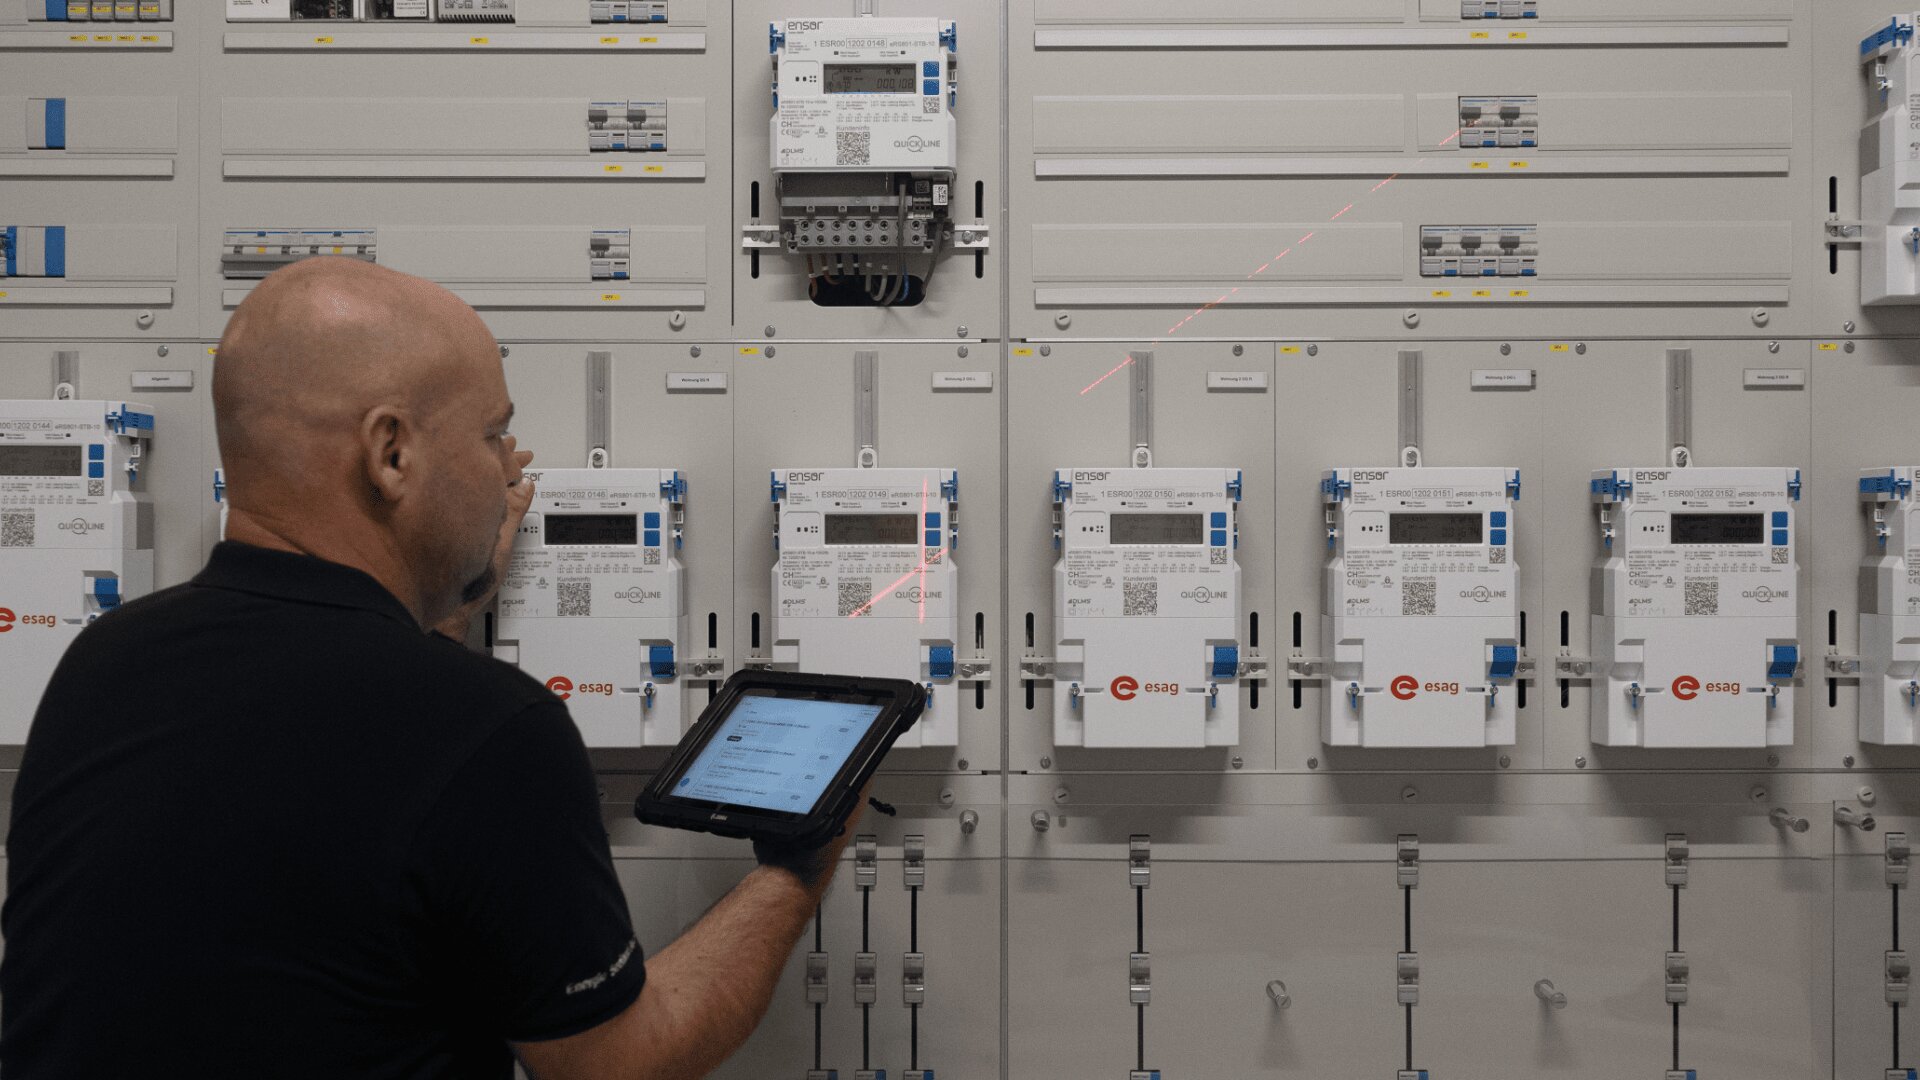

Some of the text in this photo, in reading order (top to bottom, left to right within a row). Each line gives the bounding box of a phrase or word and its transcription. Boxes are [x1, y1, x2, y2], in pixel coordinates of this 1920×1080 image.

[847, 40, 866, 48] 1202
[13, 422, 31, 430] 1202
[32, 422, 51, 430] 0144
[541, 491, 567, 499] ESR00
[868, 490, 887, 498] 0149
[1154, 490, 1173, 498] 0150
[1386, 490, 1412, 498] ESR00
[1668, 490, 1694, 498] ESR00
[22, 614, 56, 628] esag
[579, 683, 613, 696] esag
[1144, 682, 1179, 696] esag
[1424, 682, 1459, 695] esag
[1705, 682, 1740, 695] esag
